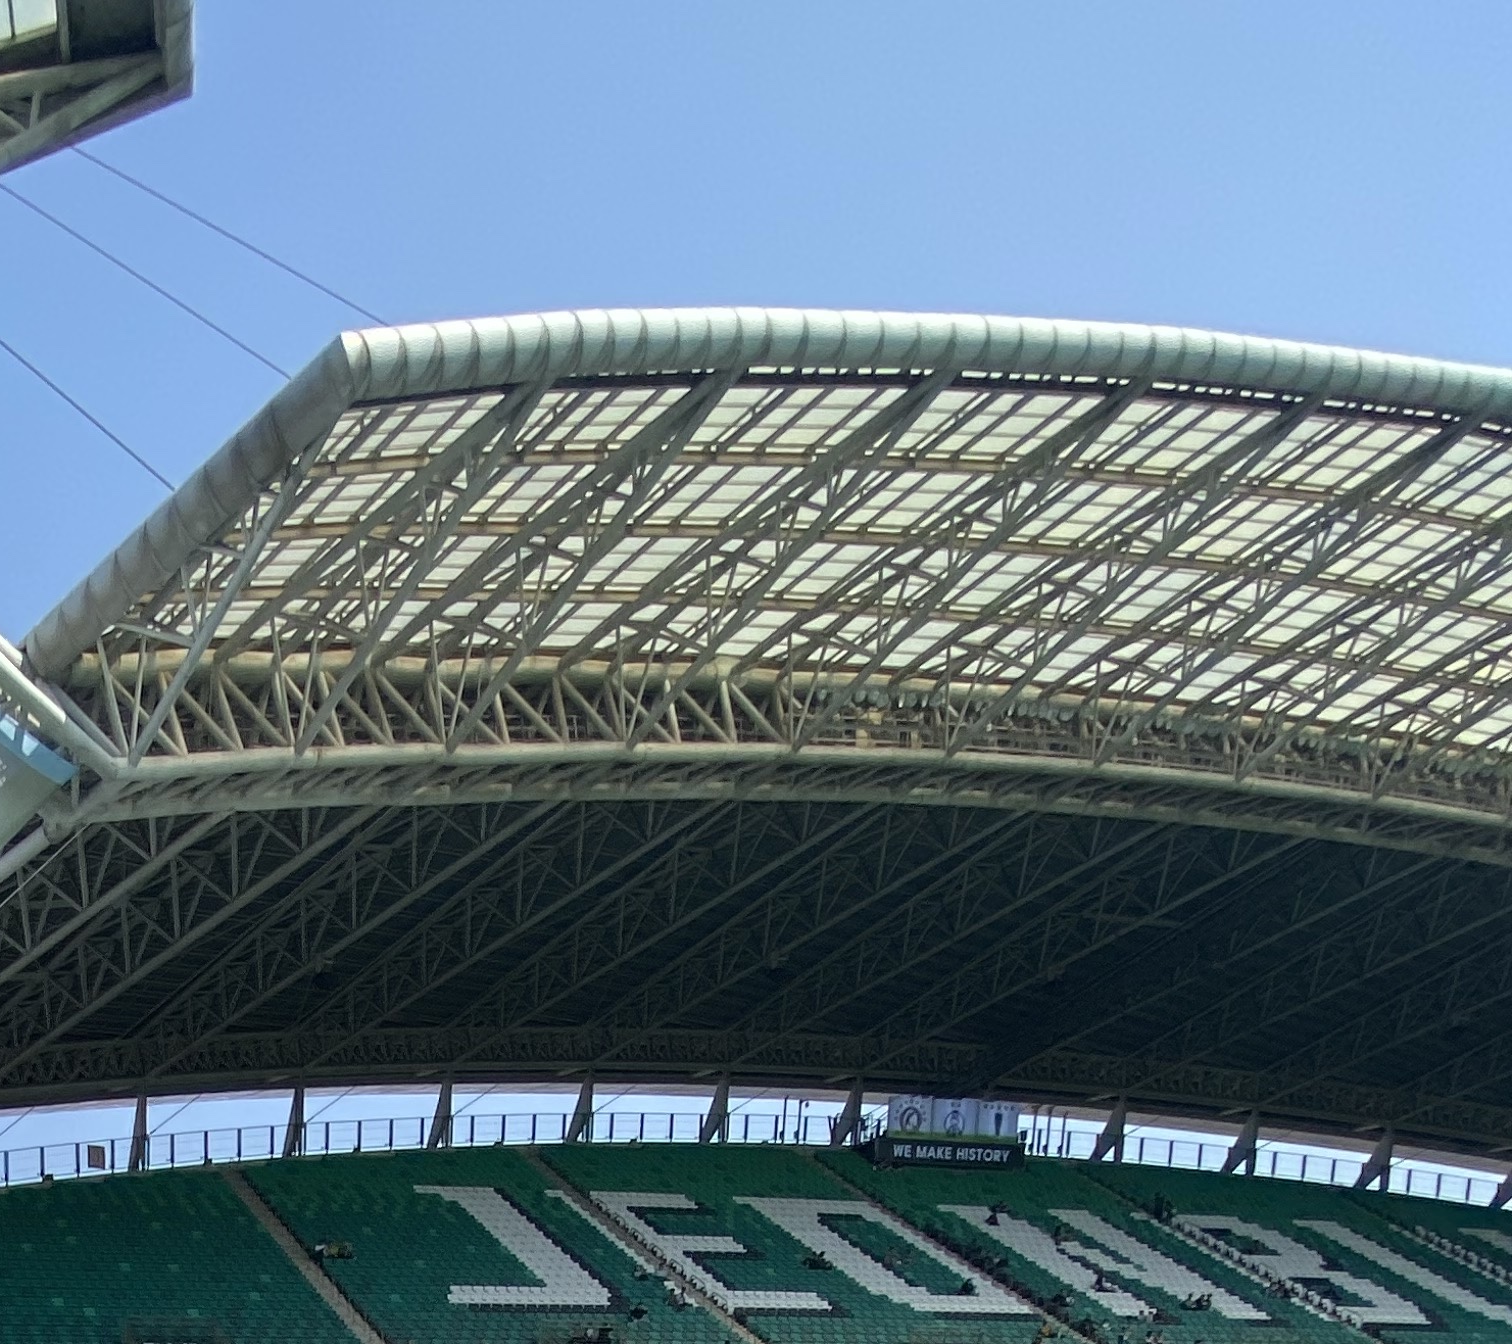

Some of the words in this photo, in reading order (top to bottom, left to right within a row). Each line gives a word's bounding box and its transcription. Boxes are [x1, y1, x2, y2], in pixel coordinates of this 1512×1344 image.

[893, 1144, 912, 1158] WE
[916, 1145, 953, 1161] MAKE
[956, 1147, 1011, 1163] HISTORY
